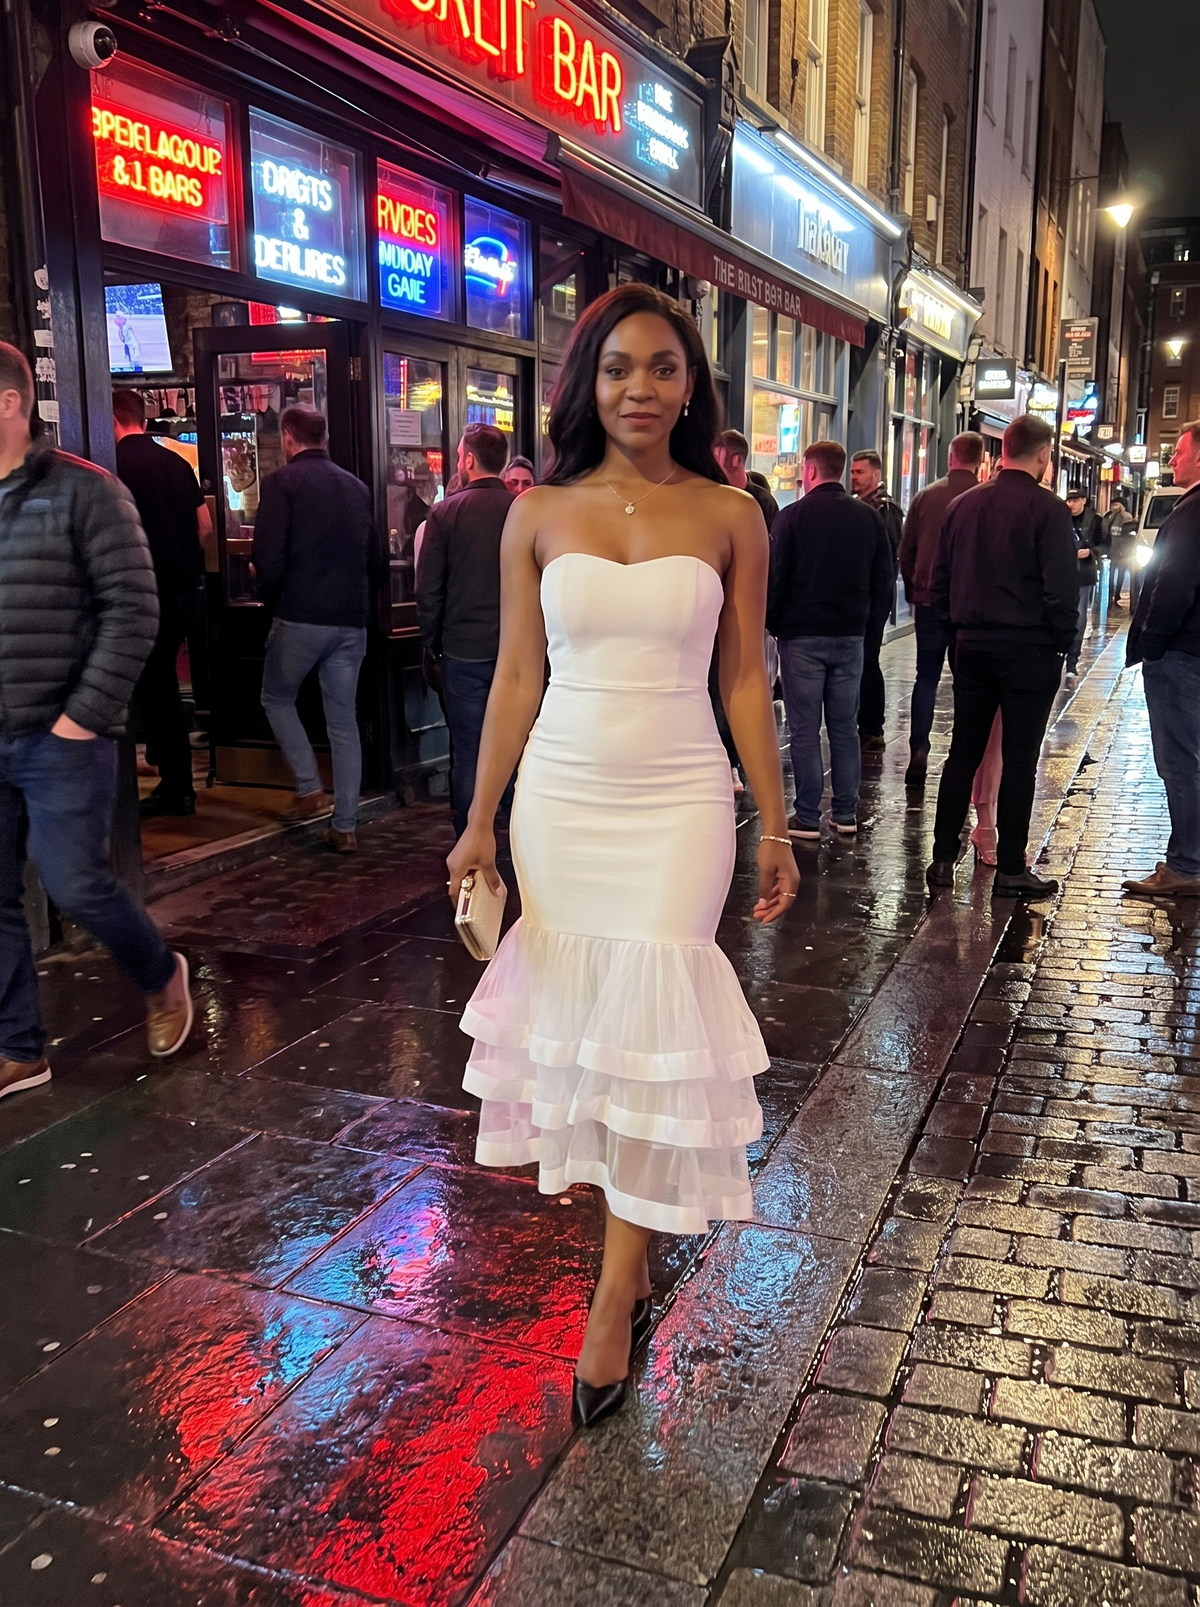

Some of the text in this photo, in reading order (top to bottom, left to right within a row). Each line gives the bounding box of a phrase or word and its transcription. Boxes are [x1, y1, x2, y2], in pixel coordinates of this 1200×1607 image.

[554, 17, 622, 131] BAR
[149, 165, 203, 207] BARS
[293, 208, 309, 240] &
[713, 254, 735, 288] THE
[784, 290, 802, 318] BAR
